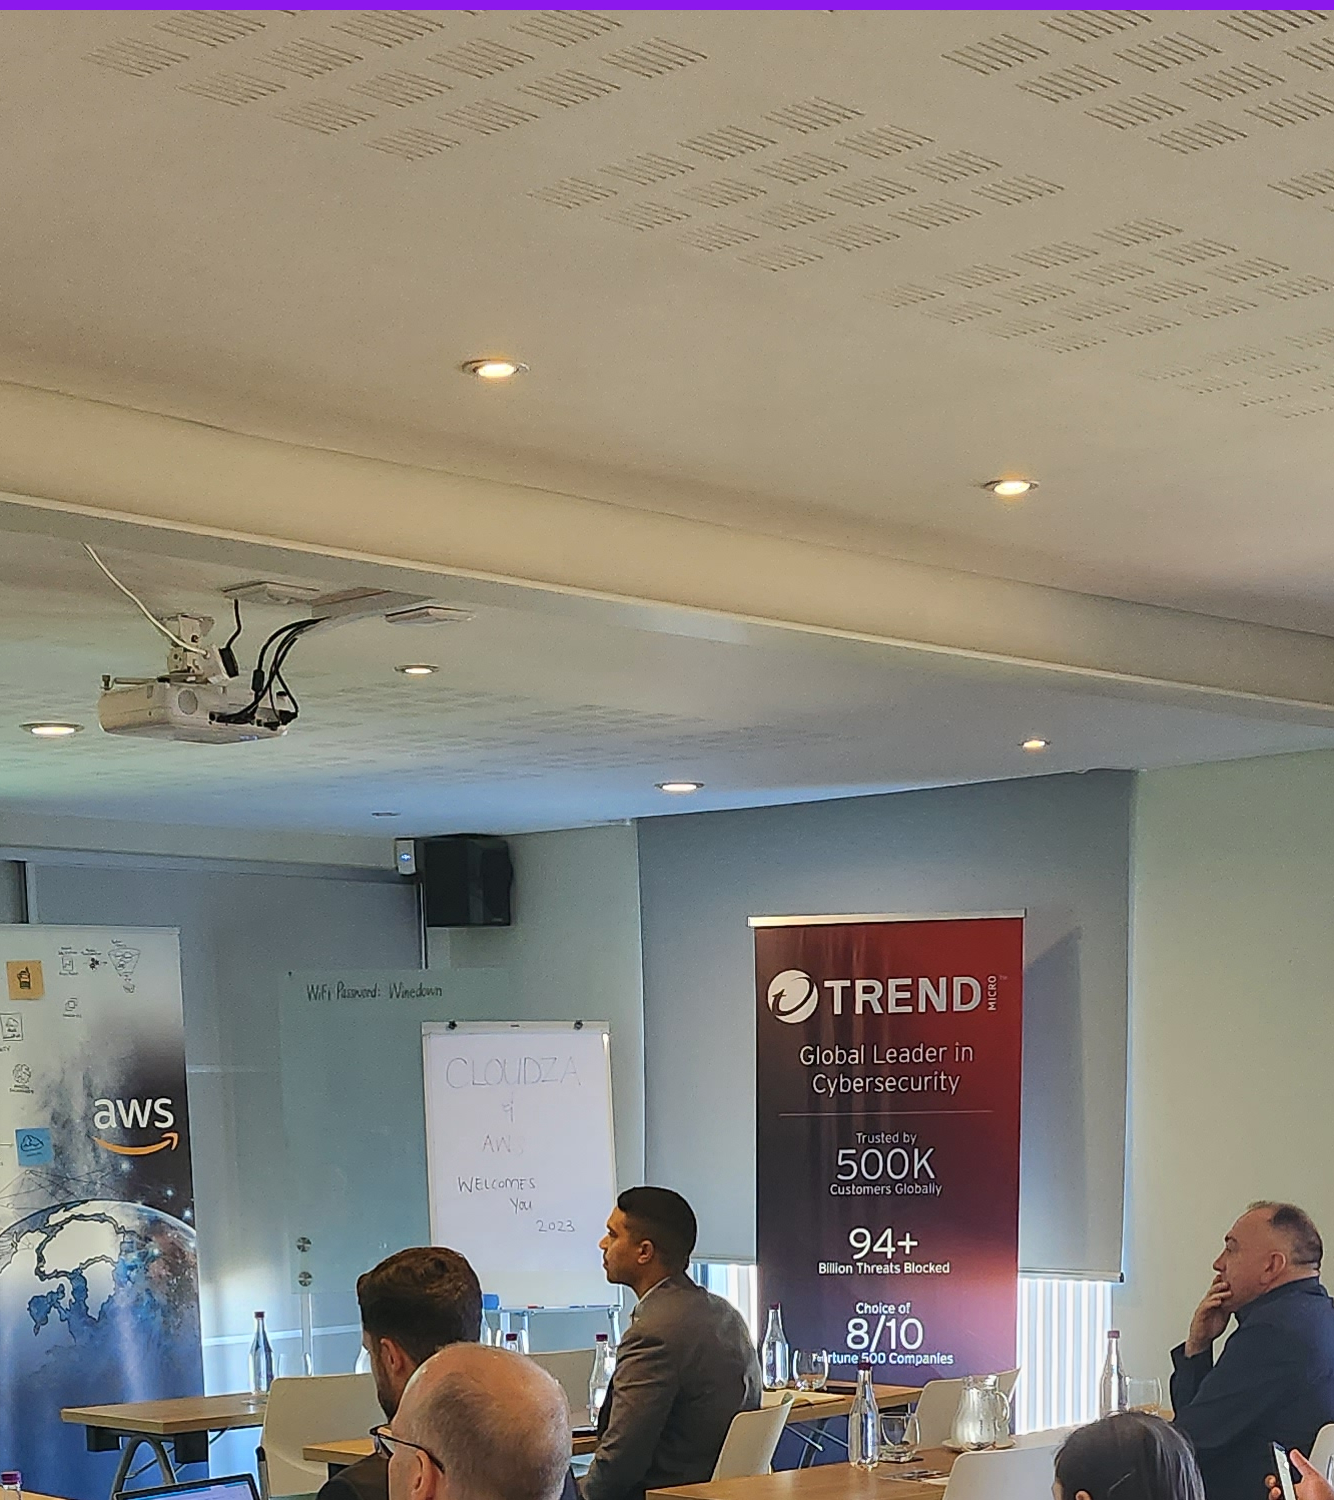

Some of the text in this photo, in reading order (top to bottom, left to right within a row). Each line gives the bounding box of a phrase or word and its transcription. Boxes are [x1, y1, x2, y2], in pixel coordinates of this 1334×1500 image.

[823, 975, 982, 1016] TREND
[987, 975, 997, 1011] MICRO
[799, 1041, 974, 1065] Global Leader in
[445, 1056, 582, 1089] CLOUDZA
[812, 1071, 961, 1098] Cybersecurity
[93, 1097, 174, 1130] aws
[856, 1131, 917, 1145] Trusted by
[836, 1147, 936, 1181] 500K
[830, 1182, 943, 1197] Customers Globally
[535, 1219, 575, 1233] 2023
[849, 1227, 918, 1260] 94+
[818, 1261, 950, 1275] Billion Threats Blocked
[855, 1302, 911, 1315] Choice of
[846, 1315, 924, 1352] 8/10
[861, 1352, 886, 1365] 500
[889, 1352, 954, 1366] Companies
